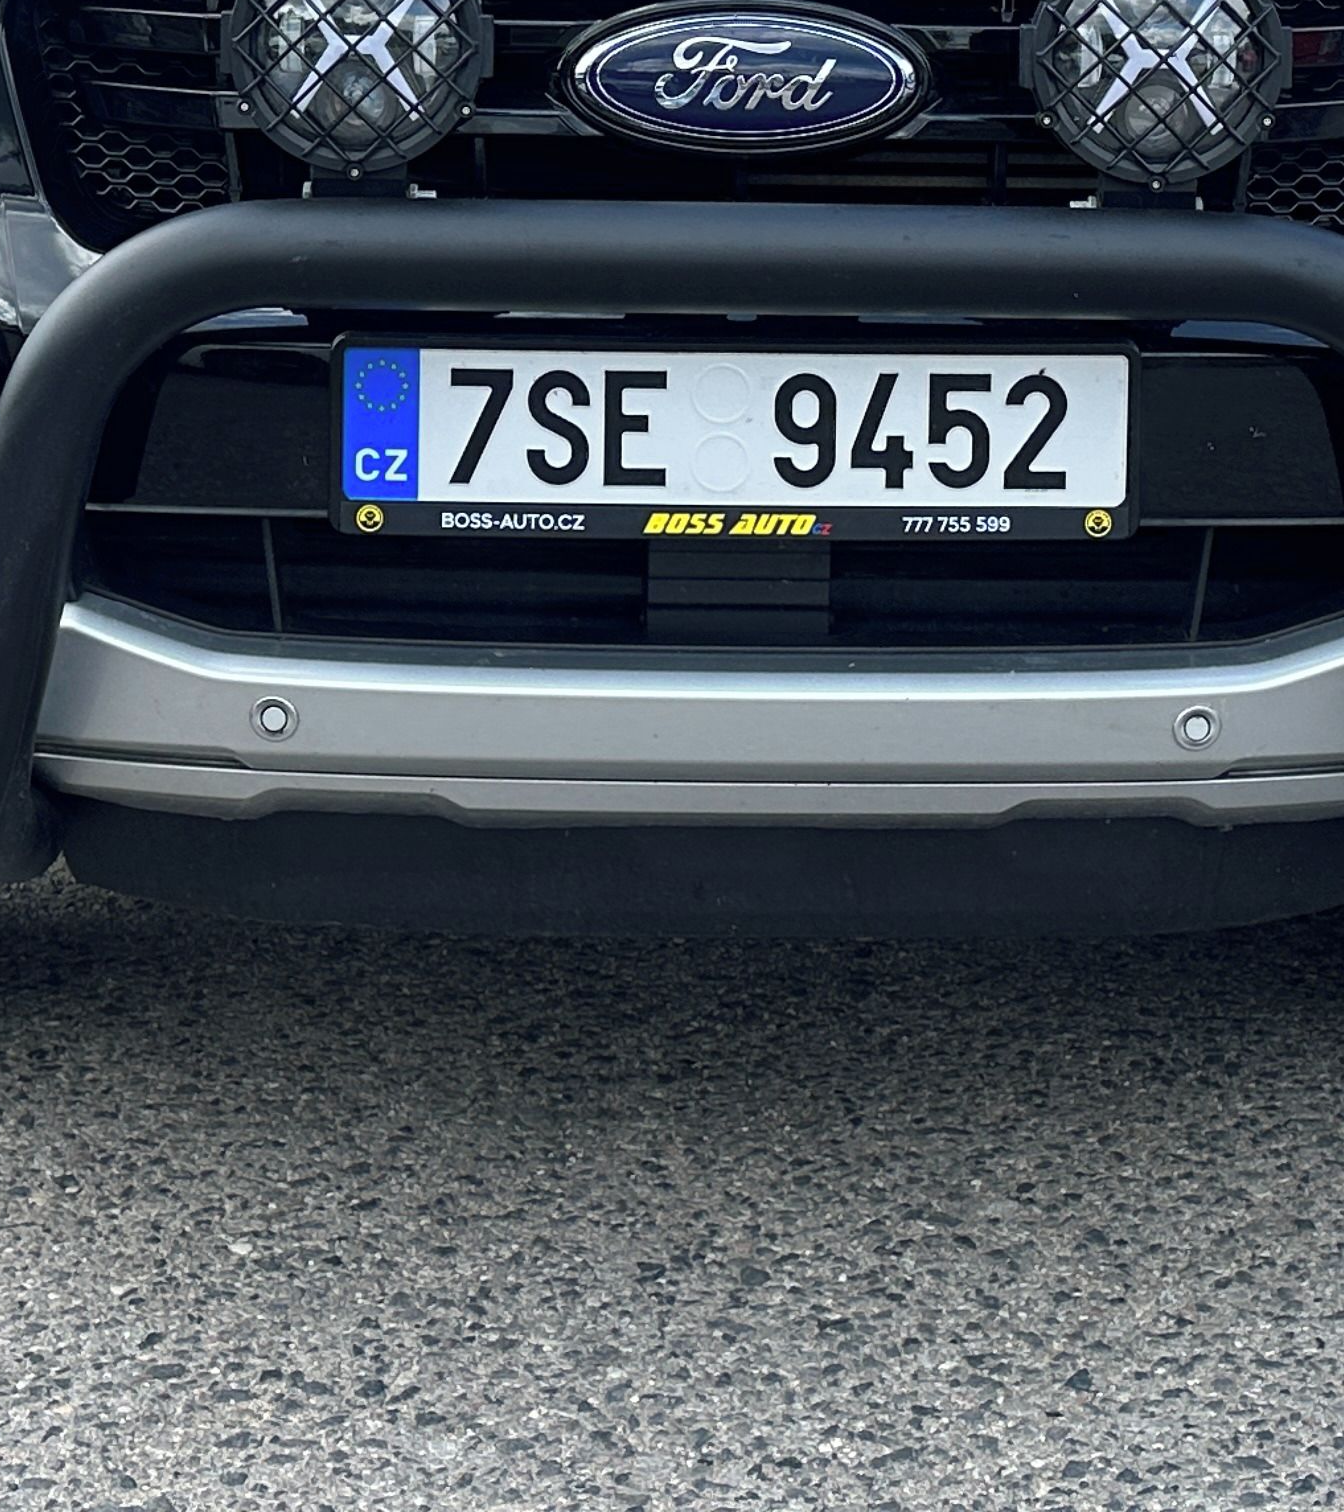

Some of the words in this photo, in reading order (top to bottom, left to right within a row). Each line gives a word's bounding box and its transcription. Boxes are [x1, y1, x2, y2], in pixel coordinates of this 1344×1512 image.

[653, 35, 836, 114] Ford
[449, 368, 667, 487] 7SE
[773, 369, 1068, 490] 9452
[355, 448, 408, 482] CZ
[441, 512, 585, 530] BOSS-AUTO.CZ
[643, 513, 725, 534] BOSS
[728, 514, 817, 535] AUTO
[902, 517, 933, 532] 777
[937, 516, 972, 532] 755
[975, 516, 1010, 532] 599
